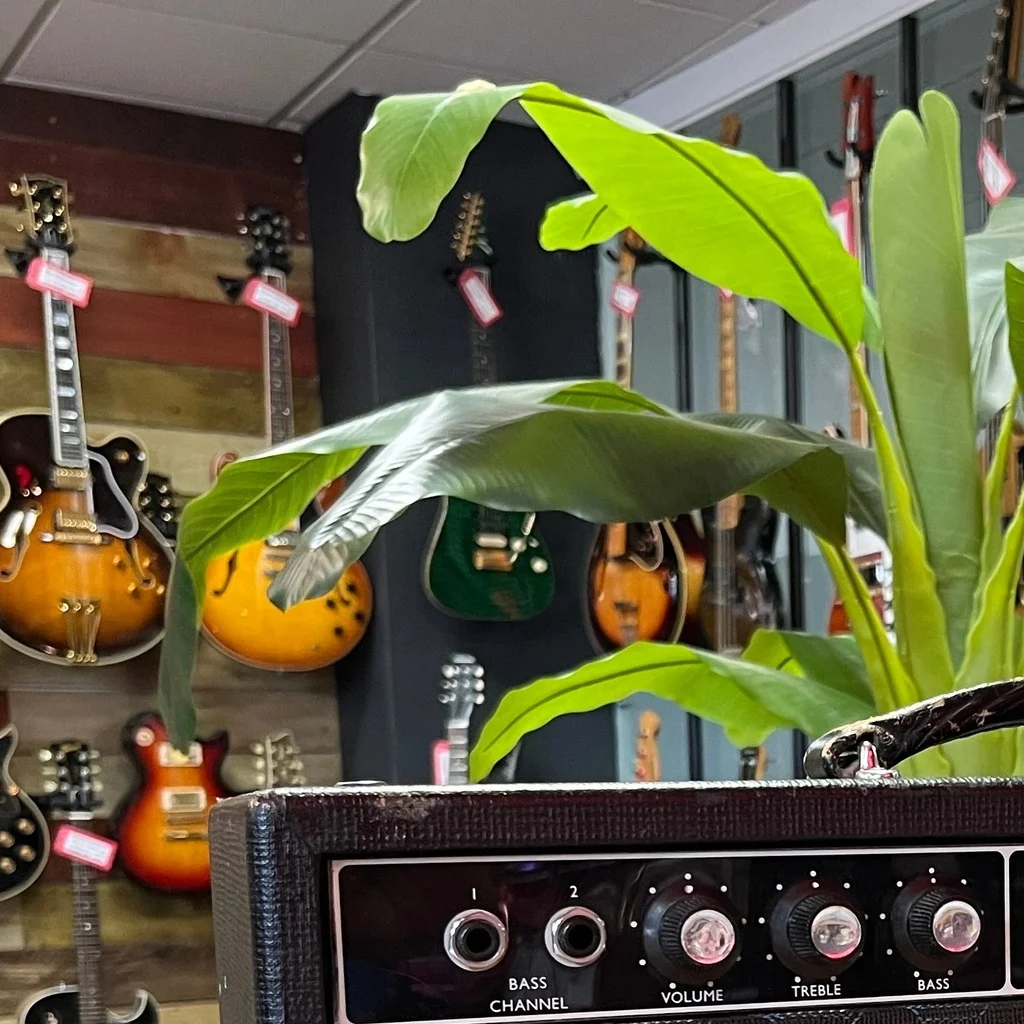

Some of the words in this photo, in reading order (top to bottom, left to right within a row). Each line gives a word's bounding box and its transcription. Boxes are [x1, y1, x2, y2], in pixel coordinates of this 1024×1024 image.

[569, 886, 579, 899] 2
[508, 976, 548, 991] BASS
[791, 983, 842, 998] TREBLE
[917, 977, 951, 992] BASS
[660, 988, 725, 1005] VOLUME
[489, 997, 569, 1014] CHANNEL
